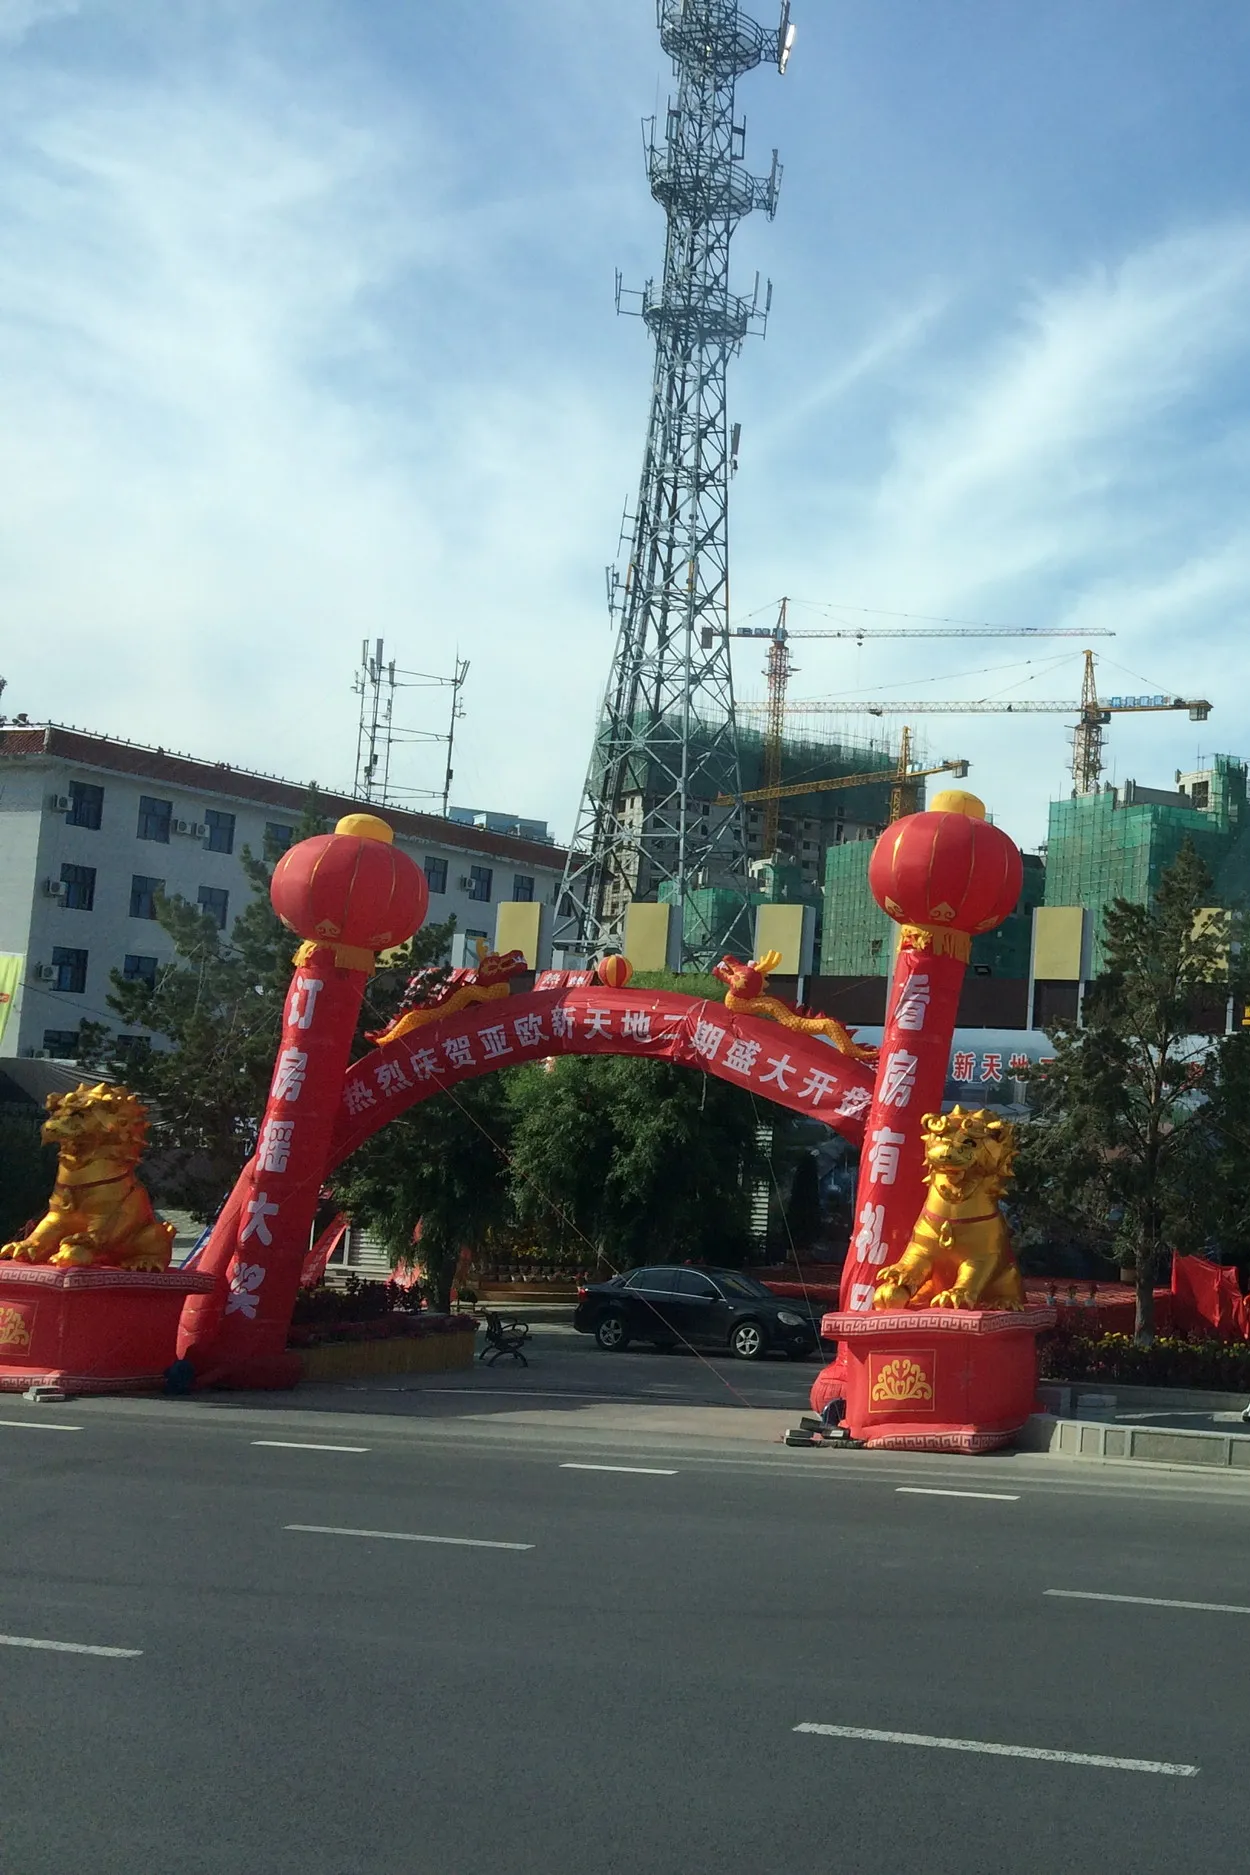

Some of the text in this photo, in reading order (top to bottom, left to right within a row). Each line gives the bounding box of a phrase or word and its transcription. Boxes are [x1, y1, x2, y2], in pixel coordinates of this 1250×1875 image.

[225, 978, 324, 1320] 订房摇大奖
[342, 1005, 873, 1121] 热烈庆贺亚欧新天地二期盛大开盘
